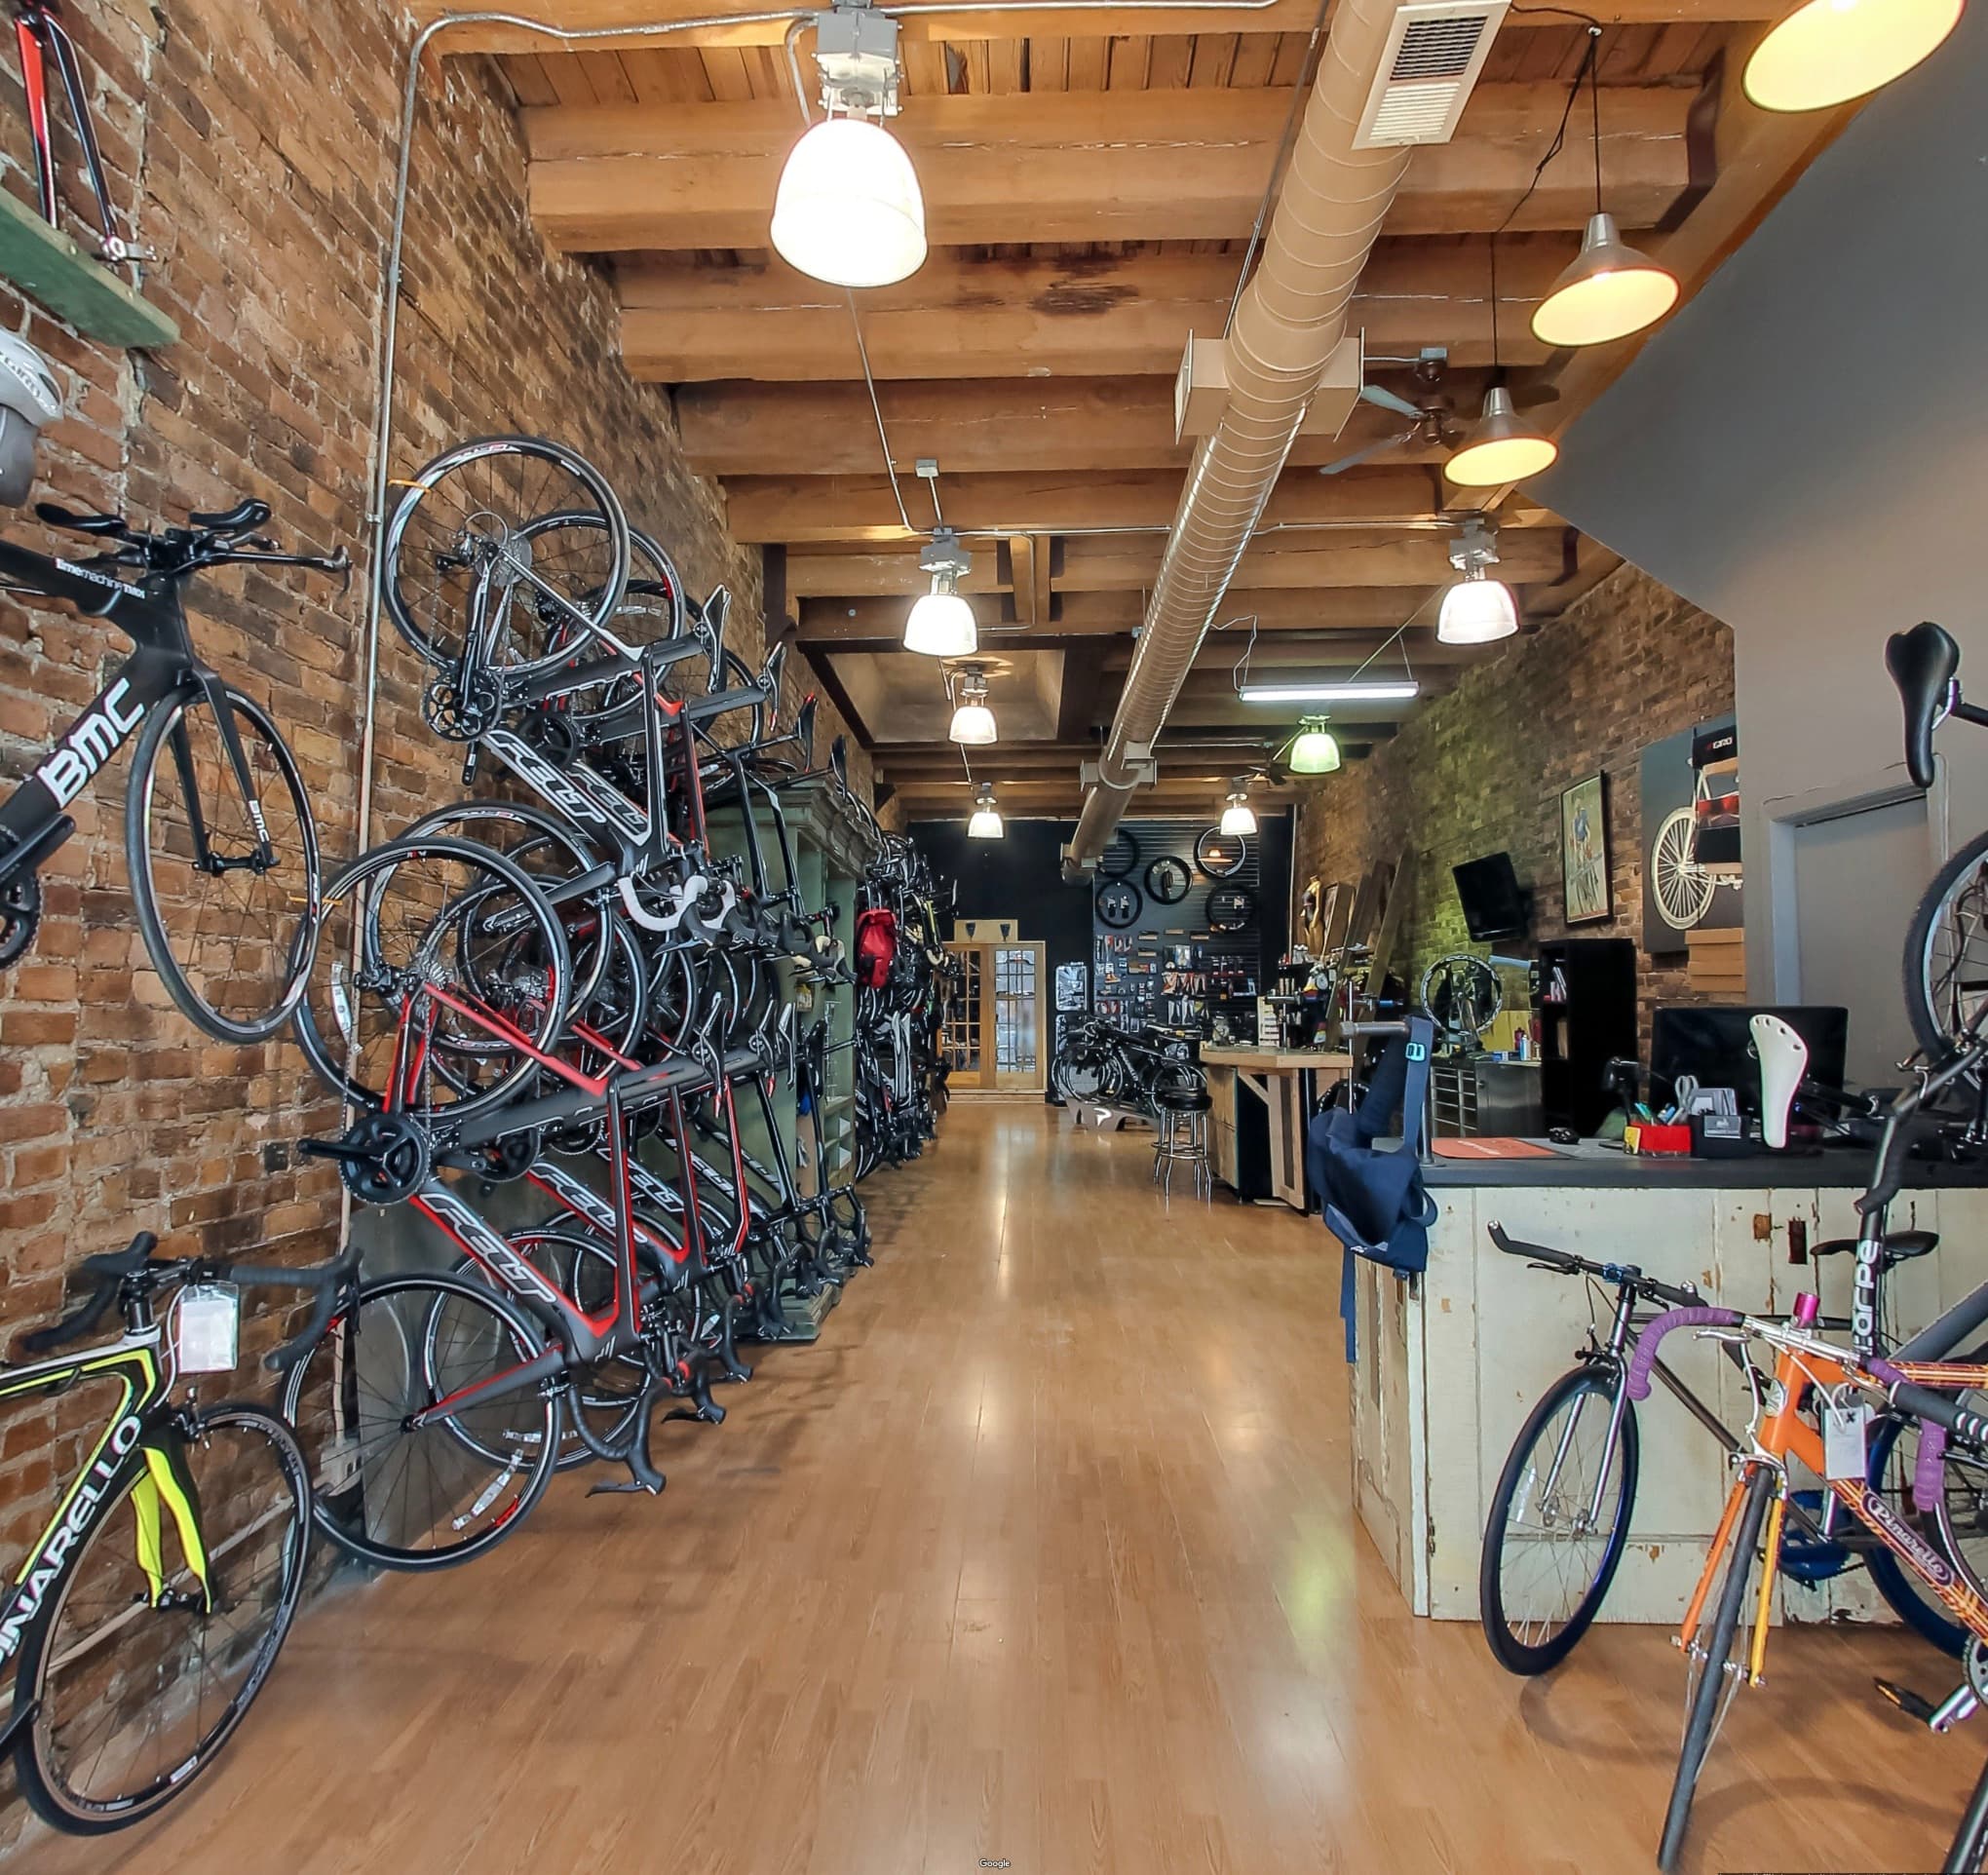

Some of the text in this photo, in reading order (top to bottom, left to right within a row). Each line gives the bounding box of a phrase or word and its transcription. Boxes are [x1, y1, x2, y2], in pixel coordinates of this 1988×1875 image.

[36, 676, 146, 809] BMC
[485, 729, 608, 823] FELT
[248, 799, 271, 843] BMC
[419, 1192, 558, 1303] FELT
[0, 1414, 141, 1665] INARELLO
[1867, 1495, 1946, 1576] Pinarello
